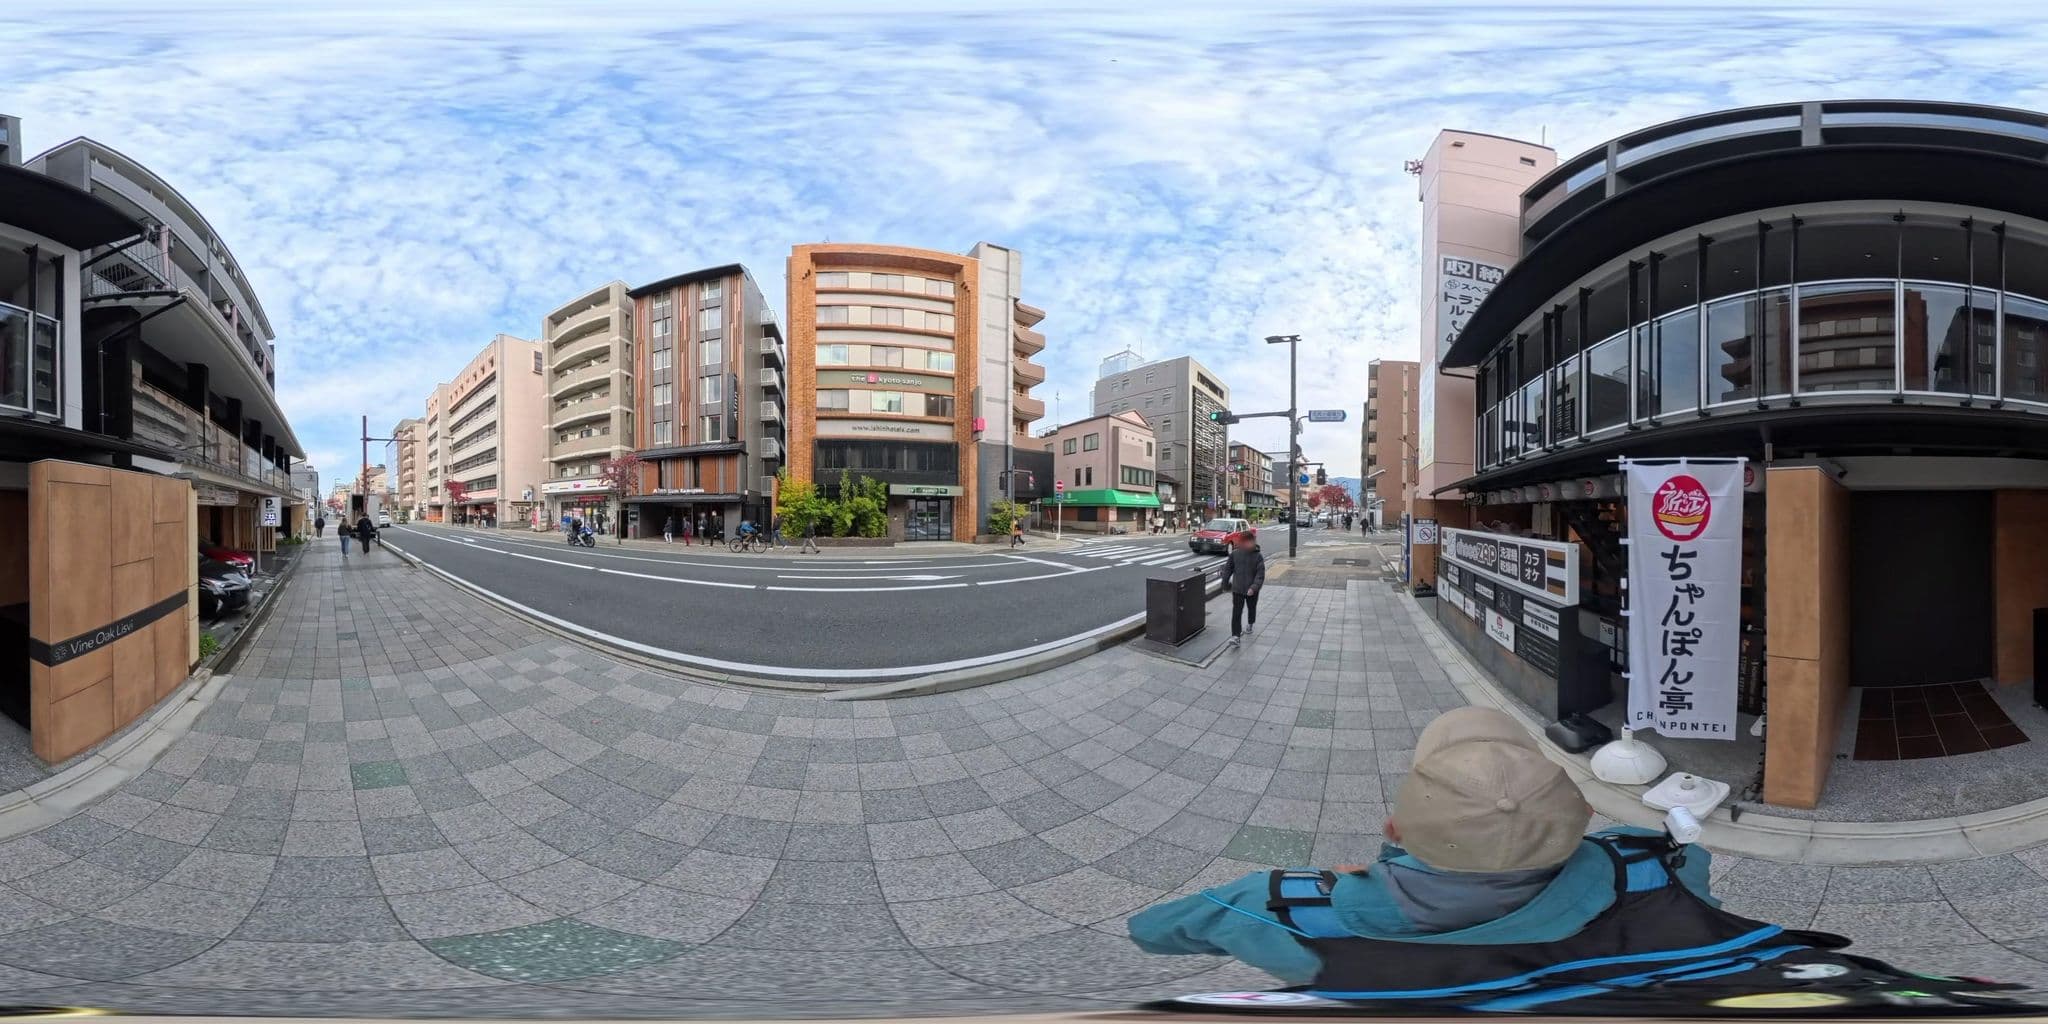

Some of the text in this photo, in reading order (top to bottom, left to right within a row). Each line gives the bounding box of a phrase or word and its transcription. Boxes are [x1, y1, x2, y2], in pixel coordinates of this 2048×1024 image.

[265, 499, 273, 508] P
[1525, 551, 1541, 566] カラ
[1525, 568, 1541, 582] オケ
[1659, 545, 1705, 715] ちゃんぽん亭
[70, 639, 94, 655] Vine
[95, 628, 115, 645] Oak
